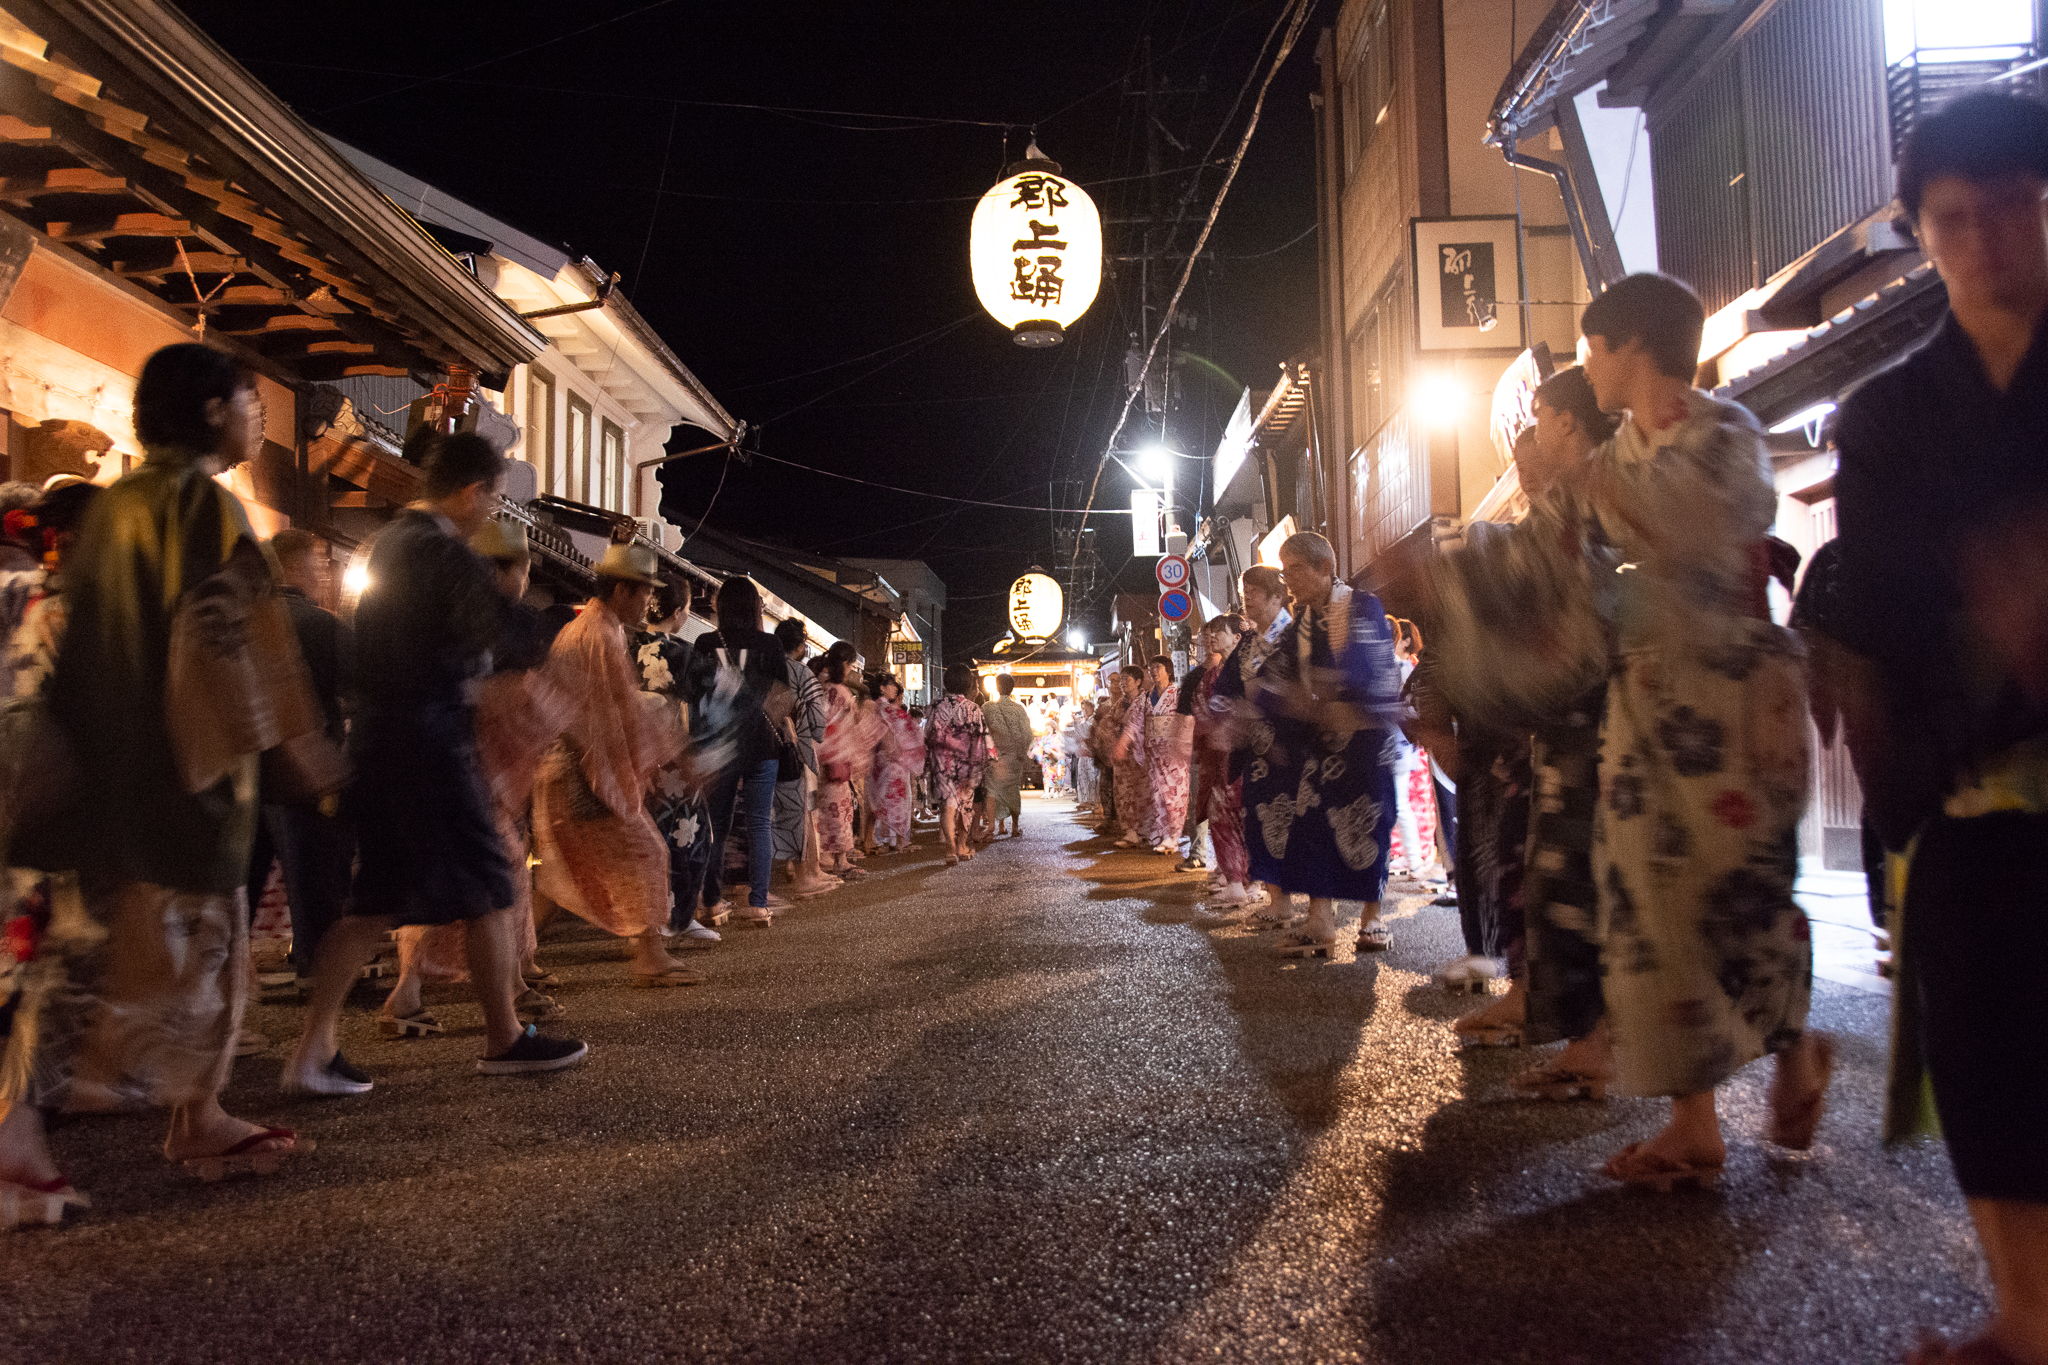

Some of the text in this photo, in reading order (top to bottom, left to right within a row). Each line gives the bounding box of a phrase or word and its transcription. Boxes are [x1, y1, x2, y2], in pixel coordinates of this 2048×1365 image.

[1010, 175, 1069, 307] 郡上踊
[1163, 563, 1182, 579] 30
[896, 652, 905, 663] P
